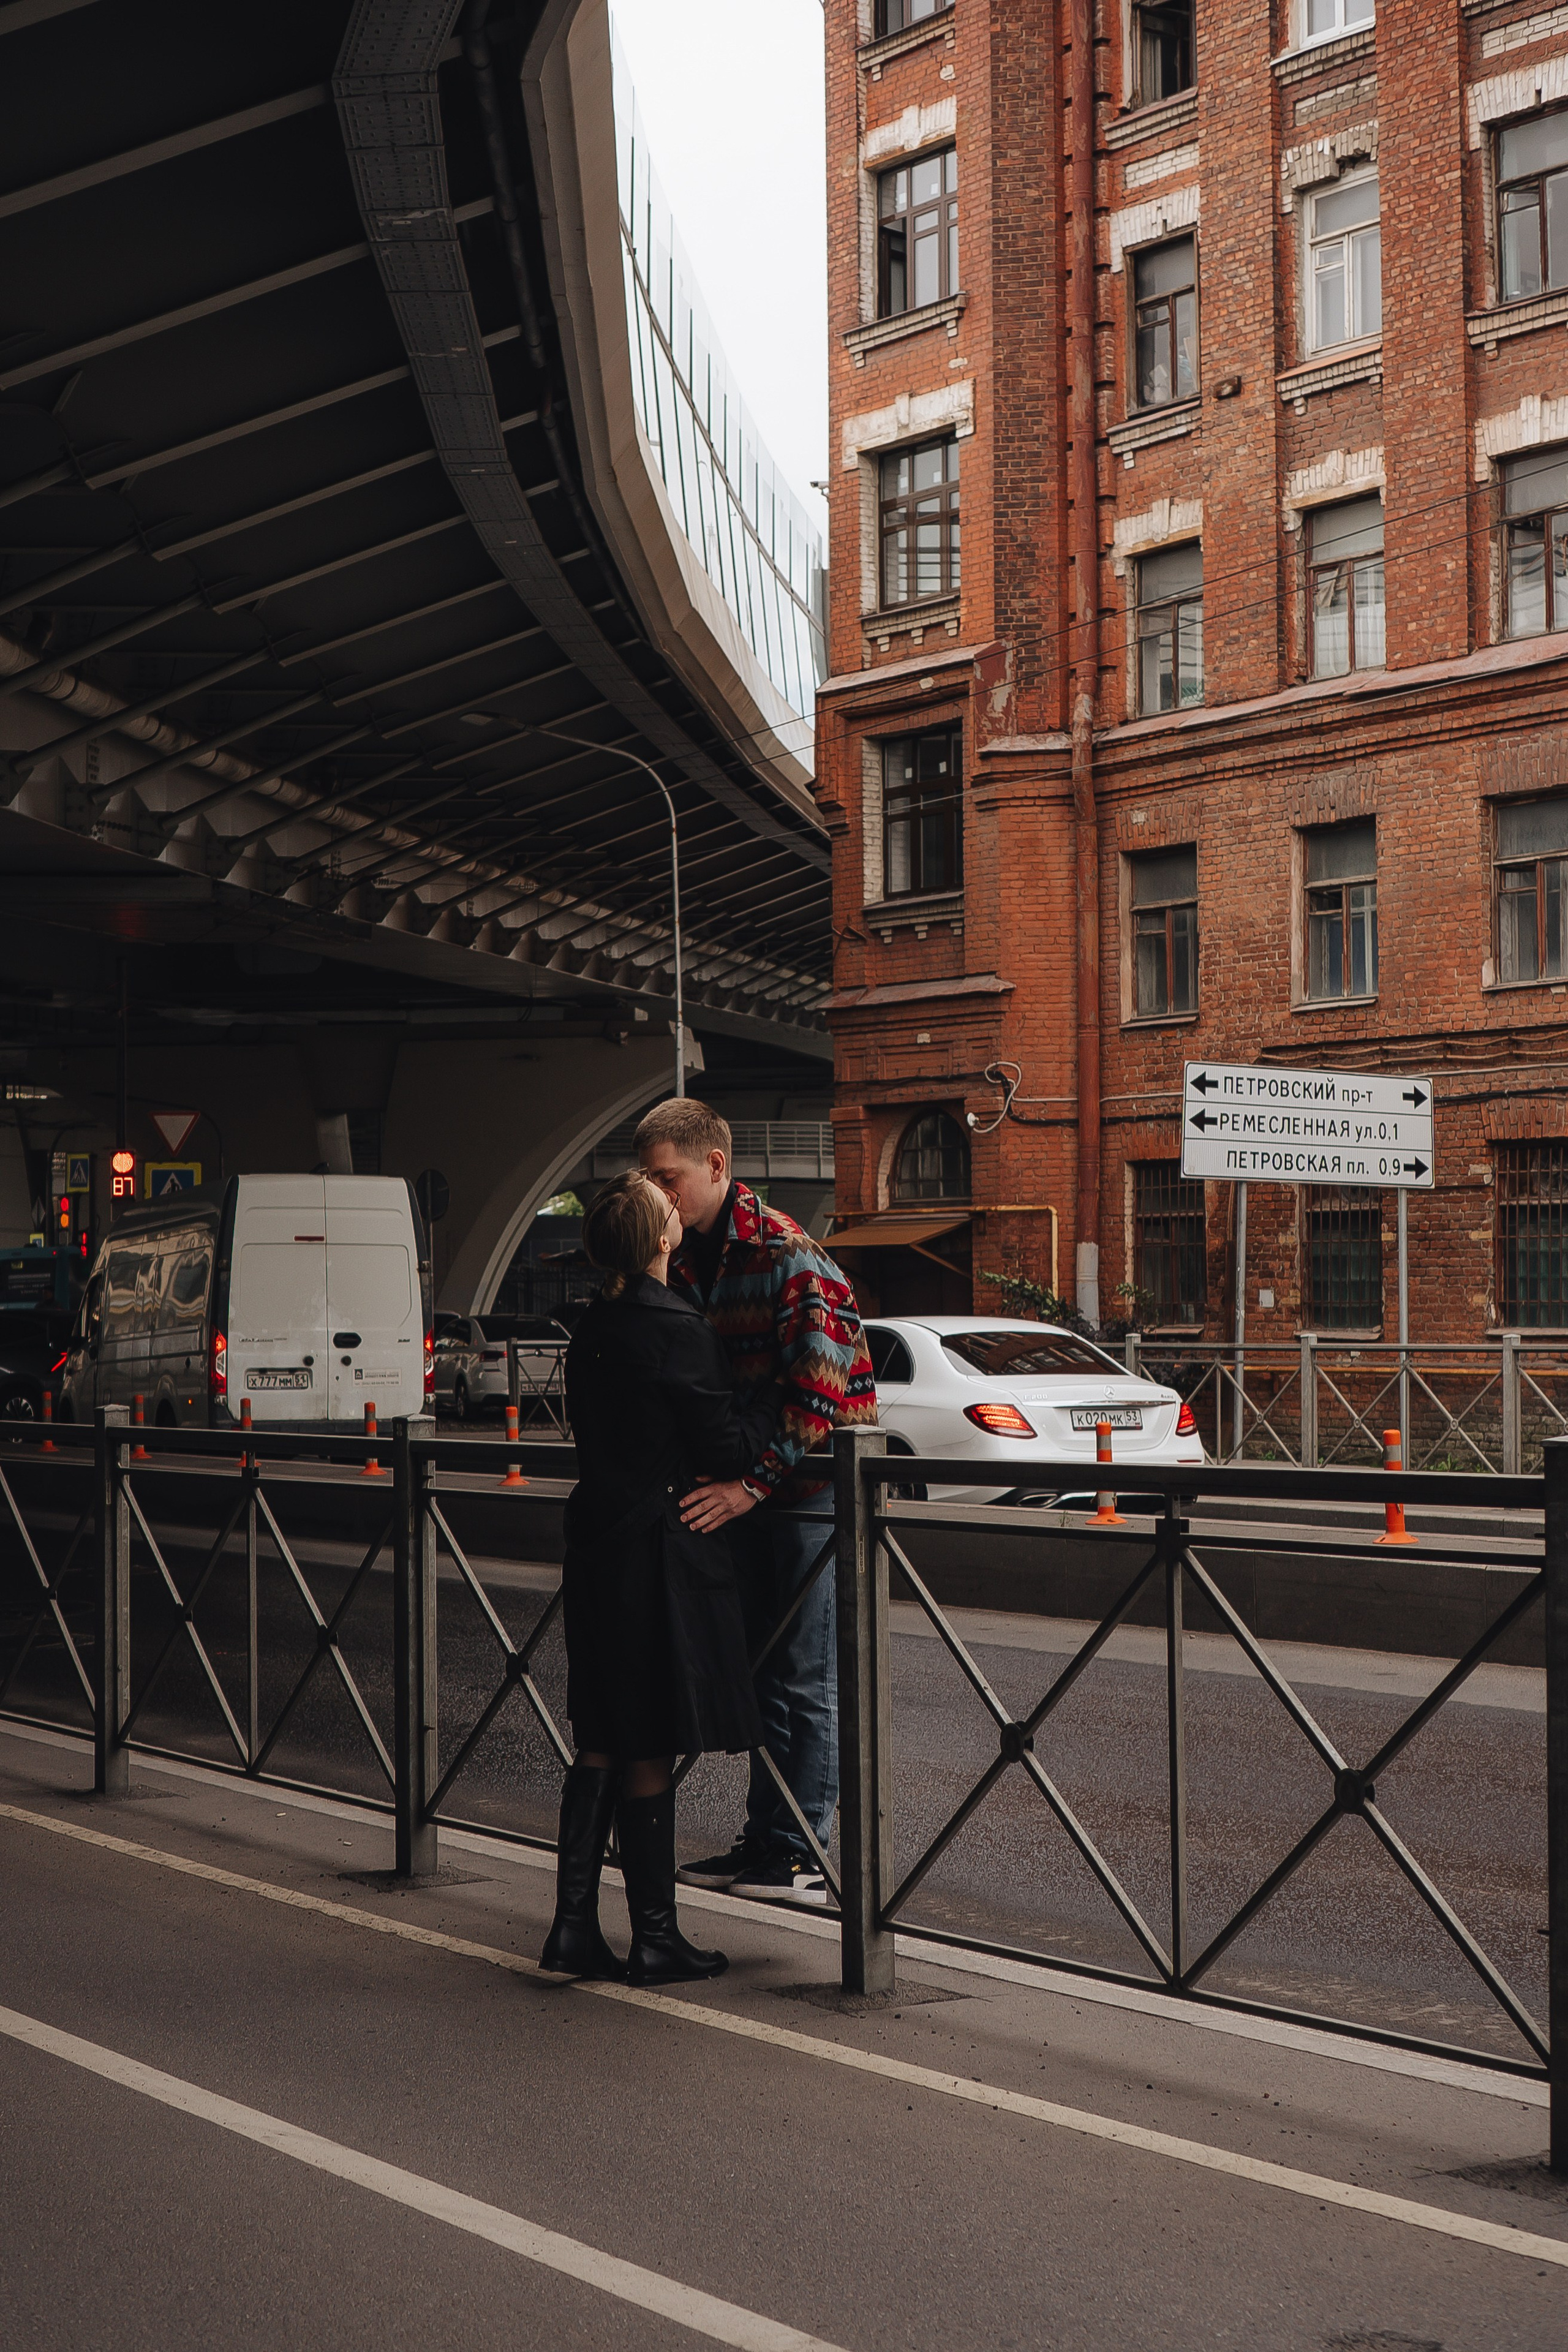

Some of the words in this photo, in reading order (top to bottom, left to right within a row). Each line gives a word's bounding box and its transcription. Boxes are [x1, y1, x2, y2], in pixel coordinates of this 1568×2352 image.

[1224, 1076, 1336, 1101] ПЕТРОВСКИЙ
[1341, 1088, 1373, 1107] пр-т
[1219, 1112, 1350, 1138] РЕМЕСЛЕННАЯ
[1226, 1150, 1341, 1174] ПЕТРОВСКАЯ
[1346, 1161, 1370, 1175] пл.
[1378, 1158, 1401, 1177] 0,9
[113, 1177, 134, 1196] 87
[1126, 1411, 1137, 1422] 53
